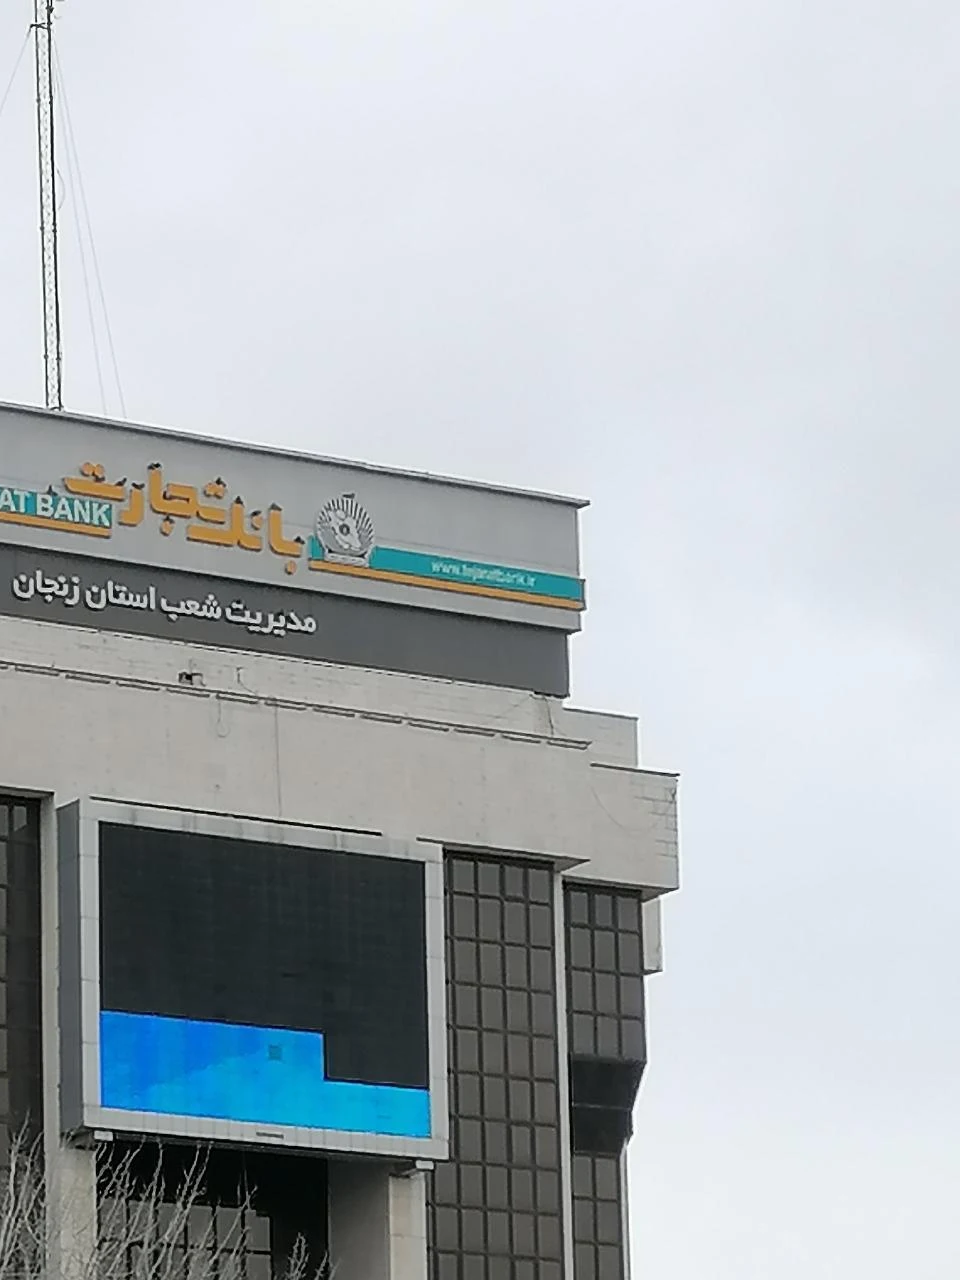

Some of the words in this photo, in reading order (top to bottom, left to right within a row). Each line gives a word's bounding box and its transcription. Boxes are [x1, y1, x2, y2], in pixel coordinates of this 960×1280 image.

[36, 491, 111, 528] BANK
[64, 462, 229, 536] تجارت
[186, 498, 305, 575] بانک
[12, 569, 80, 606] زنجان
[85, 578, 156, 612] استان
[160, 593, 222, 624] شعب
[225, 599, 317, 635] مدیریت
